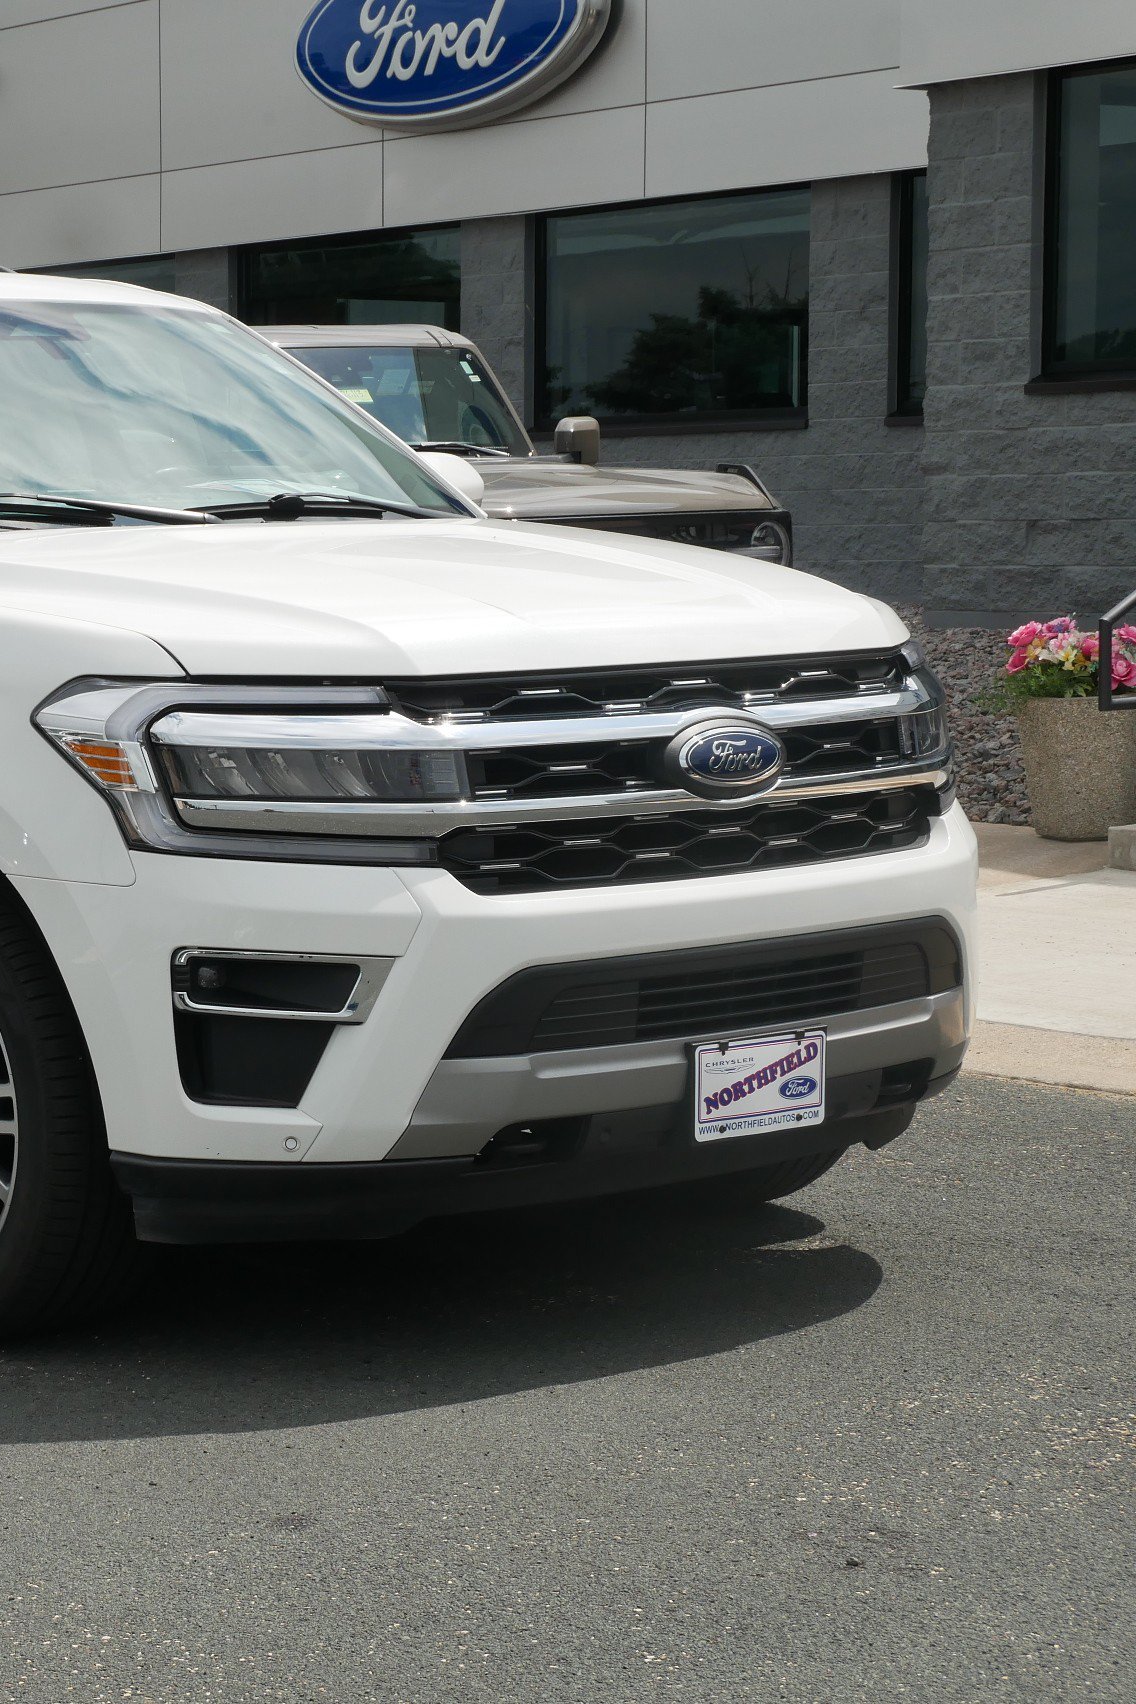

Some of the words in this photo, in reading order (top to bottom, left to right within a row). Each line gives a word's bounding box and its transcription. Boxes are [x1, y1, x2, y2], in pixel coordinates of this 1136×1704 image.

[345, 0, 506, 89] Ford
[709, 739, 763, 773] Ford
[705, 1057, 754, 1068] CHRYSLER
[703, 1041, 819, 1115] NORTHFIELD
[785, 1079, 810, 1096] Ford
[698, 1109, 820, 1136] WWWNORTHFIELDAUTOSCOM
